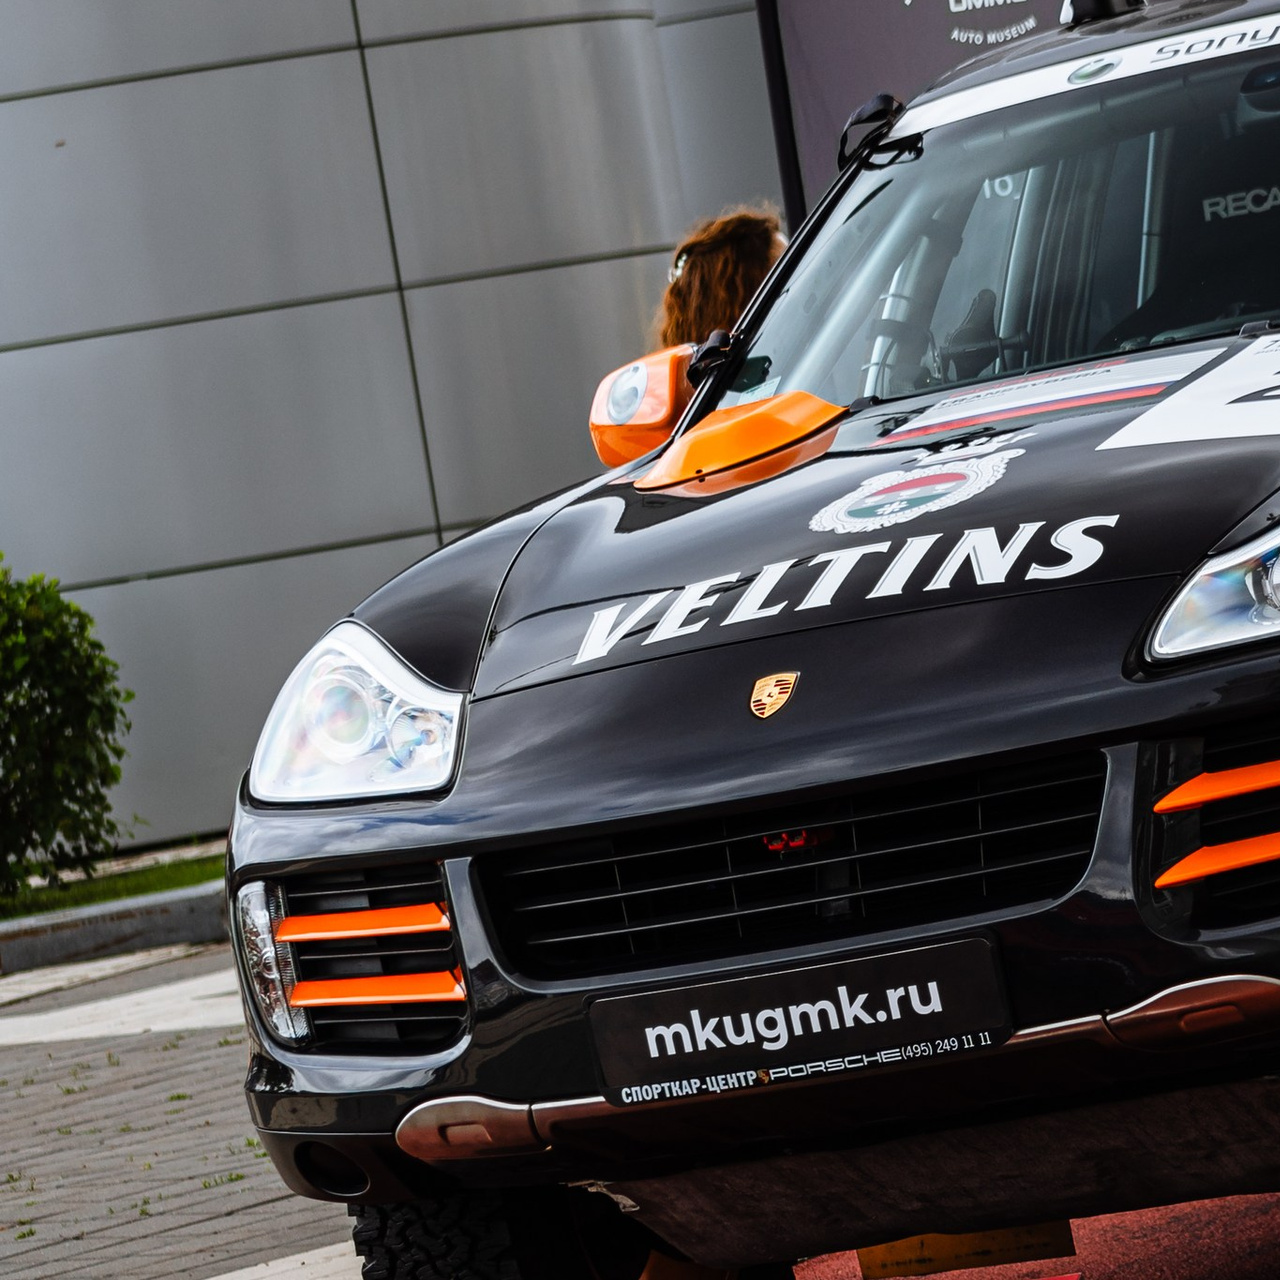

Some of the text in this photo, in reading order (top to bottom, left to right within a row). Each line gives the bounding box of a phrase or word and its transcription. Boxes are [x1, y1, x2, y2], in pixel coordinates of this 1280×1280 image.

[951, 18, 1037, 45] AUTO MUSEUM
[1150, 24, 1278, 66] Sony
[573, 515, 1120, 665] VELTINS
[644, 981, 943, 1059] mkugmk.ru
[621, 1032, 991, 1104] СПОРТКАР-ЦЕНТР PORSCHE (495) 249 11 11
